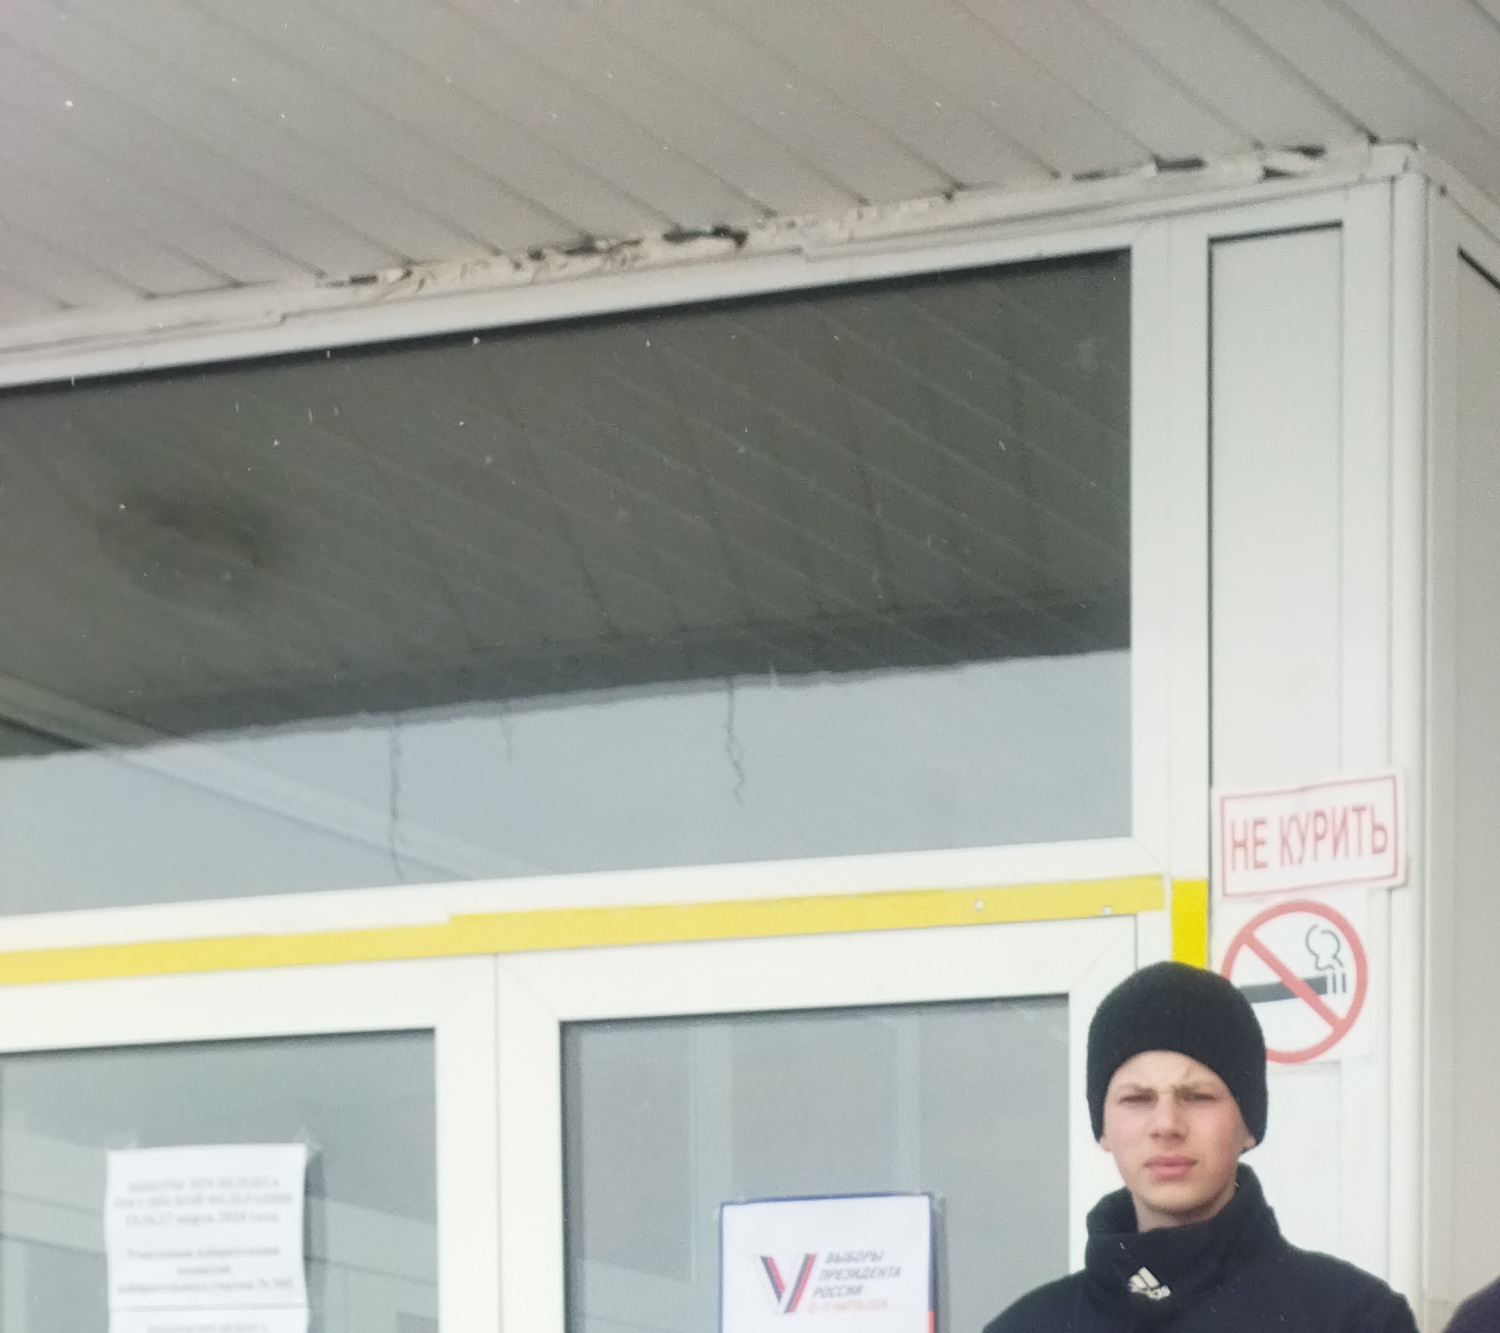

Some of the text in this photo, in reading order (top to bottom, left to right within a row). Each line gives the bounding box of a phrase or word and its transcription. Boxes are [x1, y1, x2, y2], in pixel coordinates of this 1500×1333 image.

[1231, 802, 1389, 871] НЕ КУРИТЬ
[825, 1250, 885, 1264] ВЫБОРЫ
[819, 1266, 901, 1281] ПРЕЗИДЕНТА
[812, 1284, 864, 1298] РОССИИ
